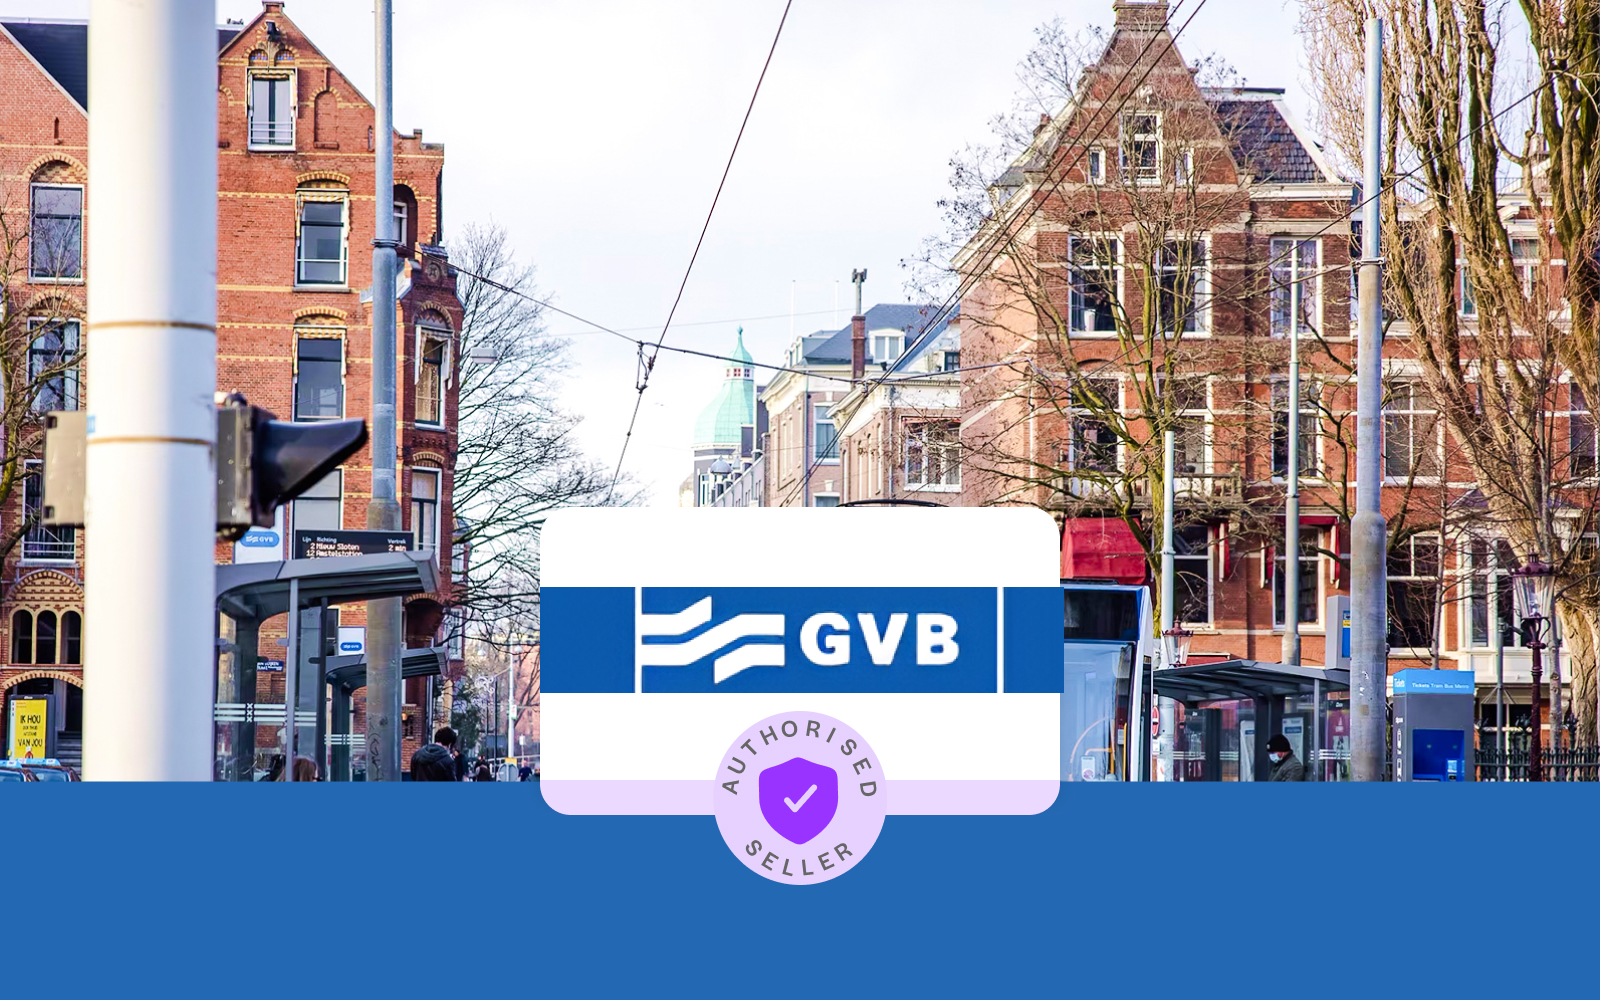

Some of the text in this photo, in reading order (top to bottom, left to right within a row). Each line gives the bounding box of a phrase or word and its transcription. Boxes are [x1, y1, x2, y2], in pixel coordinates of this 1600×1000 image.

[395, 544, 406, 552] min
[20, 715, 40, 723] IK HOU
[32, 739, 42, 747] JOU
